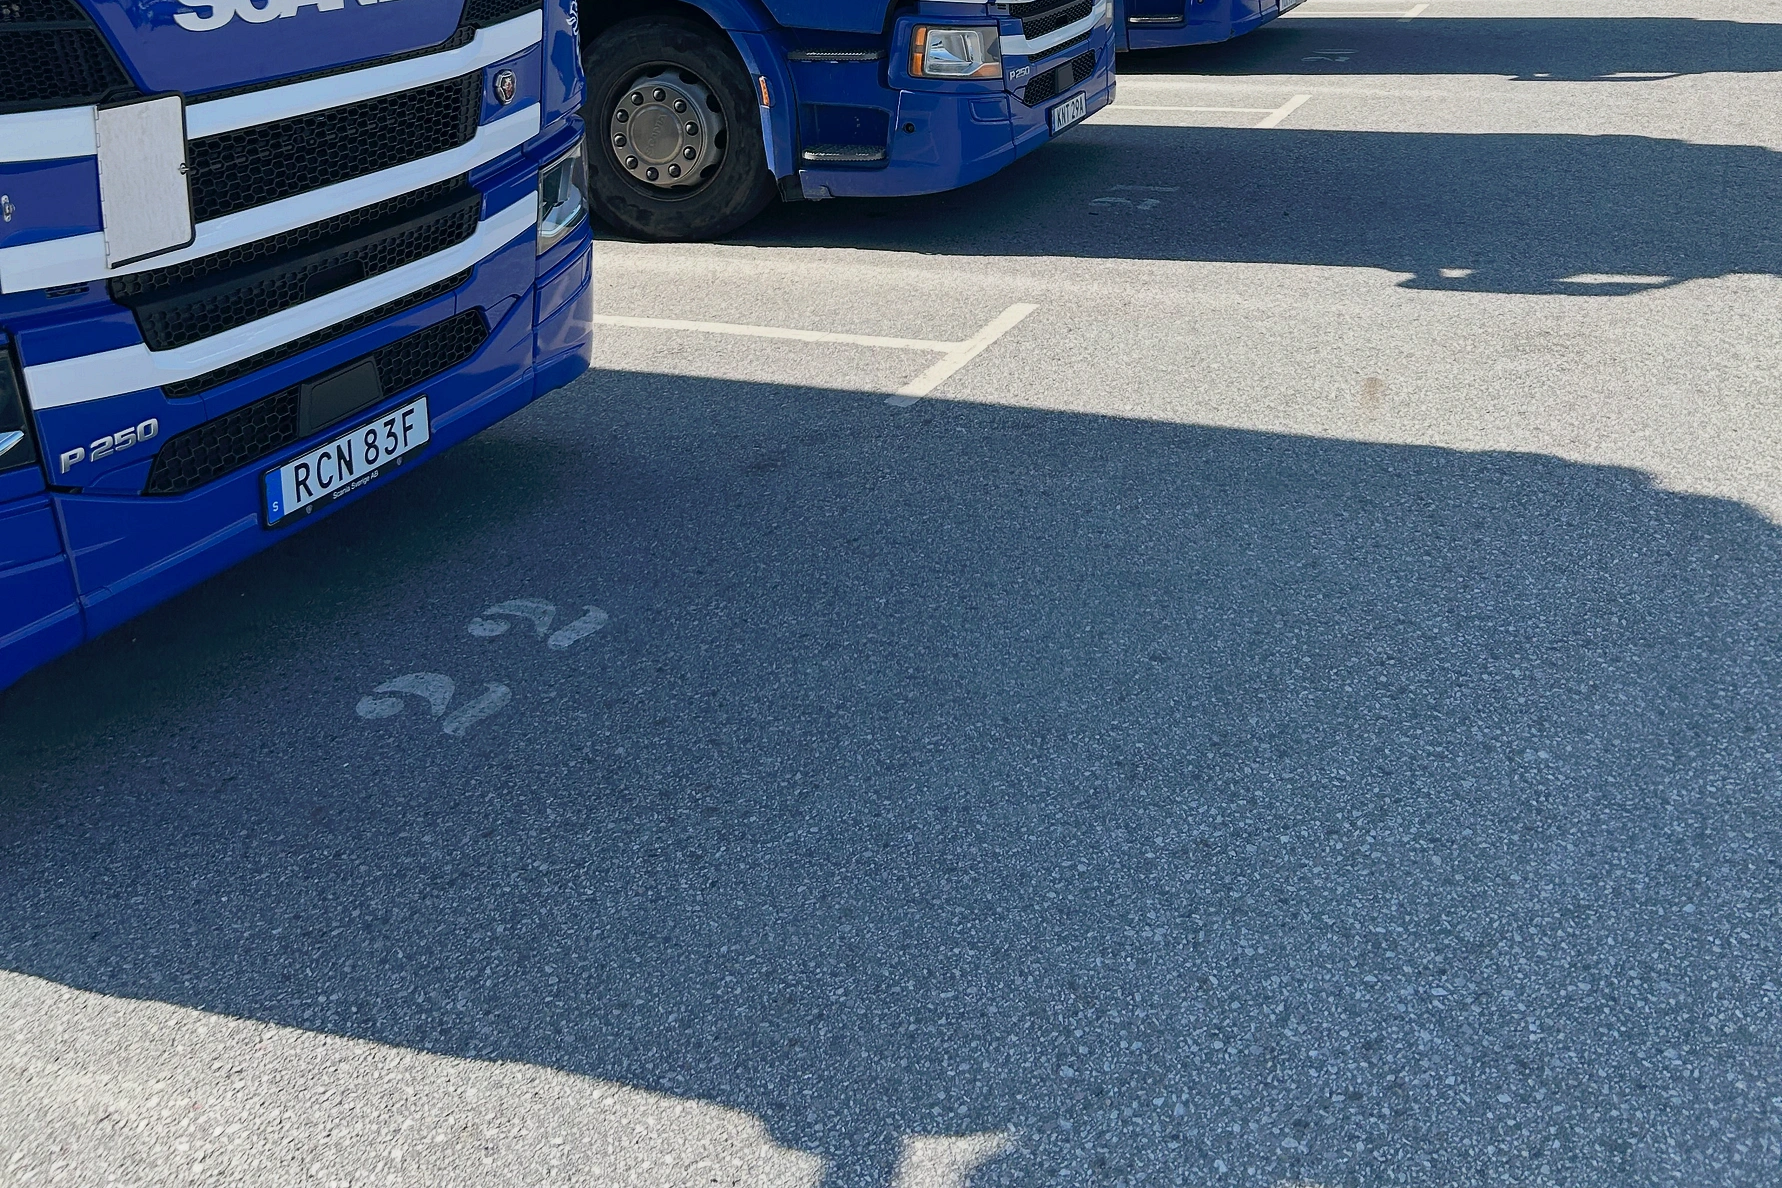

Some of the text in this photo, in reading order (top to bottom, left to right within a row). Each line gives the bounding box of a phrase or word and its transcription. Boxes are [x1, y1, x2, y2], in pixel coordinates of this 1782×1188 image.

[1009, 66, 1030, 81] P 250
[60, 417, 159, 474] P 250
[272, 408, 416, 512] S RCN 83F
[333, 486, 351, 500] Scania
